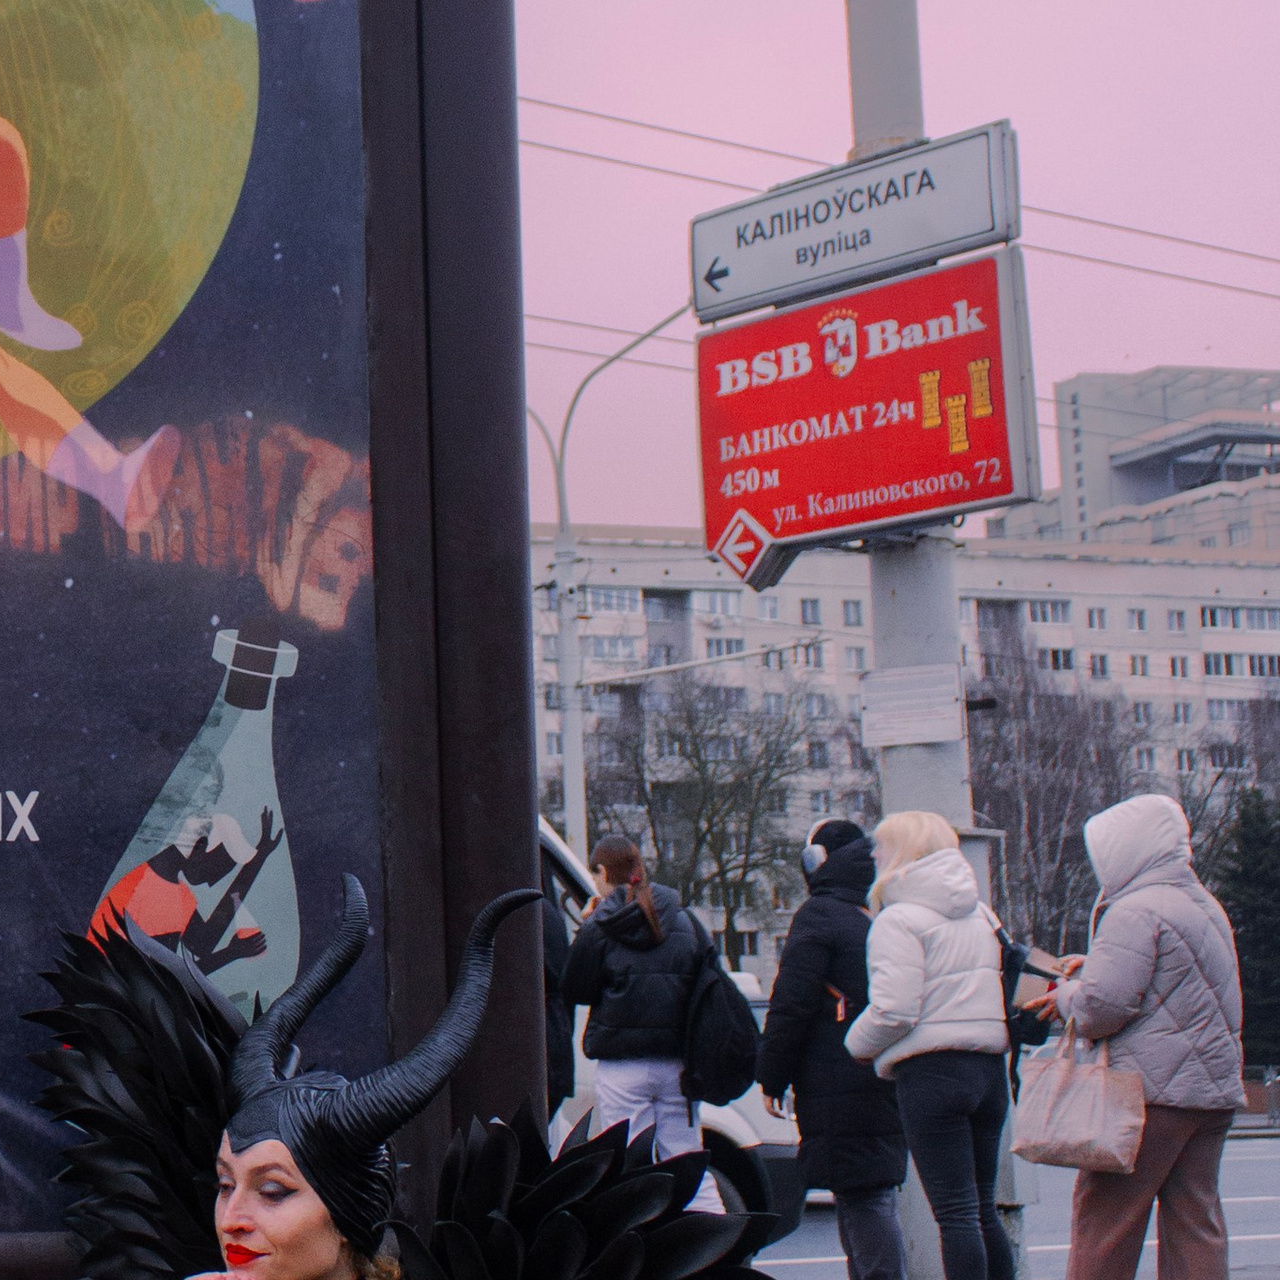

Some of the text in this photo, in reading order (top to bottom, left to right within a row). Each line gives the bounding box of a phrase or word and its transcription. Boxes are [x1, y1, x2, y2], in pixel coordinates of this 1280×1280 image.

[736, 167, 935, 248] КАЛІНОЎСКАГА
[796, 227, 871, 266] вуліца
[715, 299, 987, 397] BSB Bank
[719, 399, 915, 462] БАНКОМАТ 24ч
[772, 457, 1003, 533] ул. Калиновского, 72
